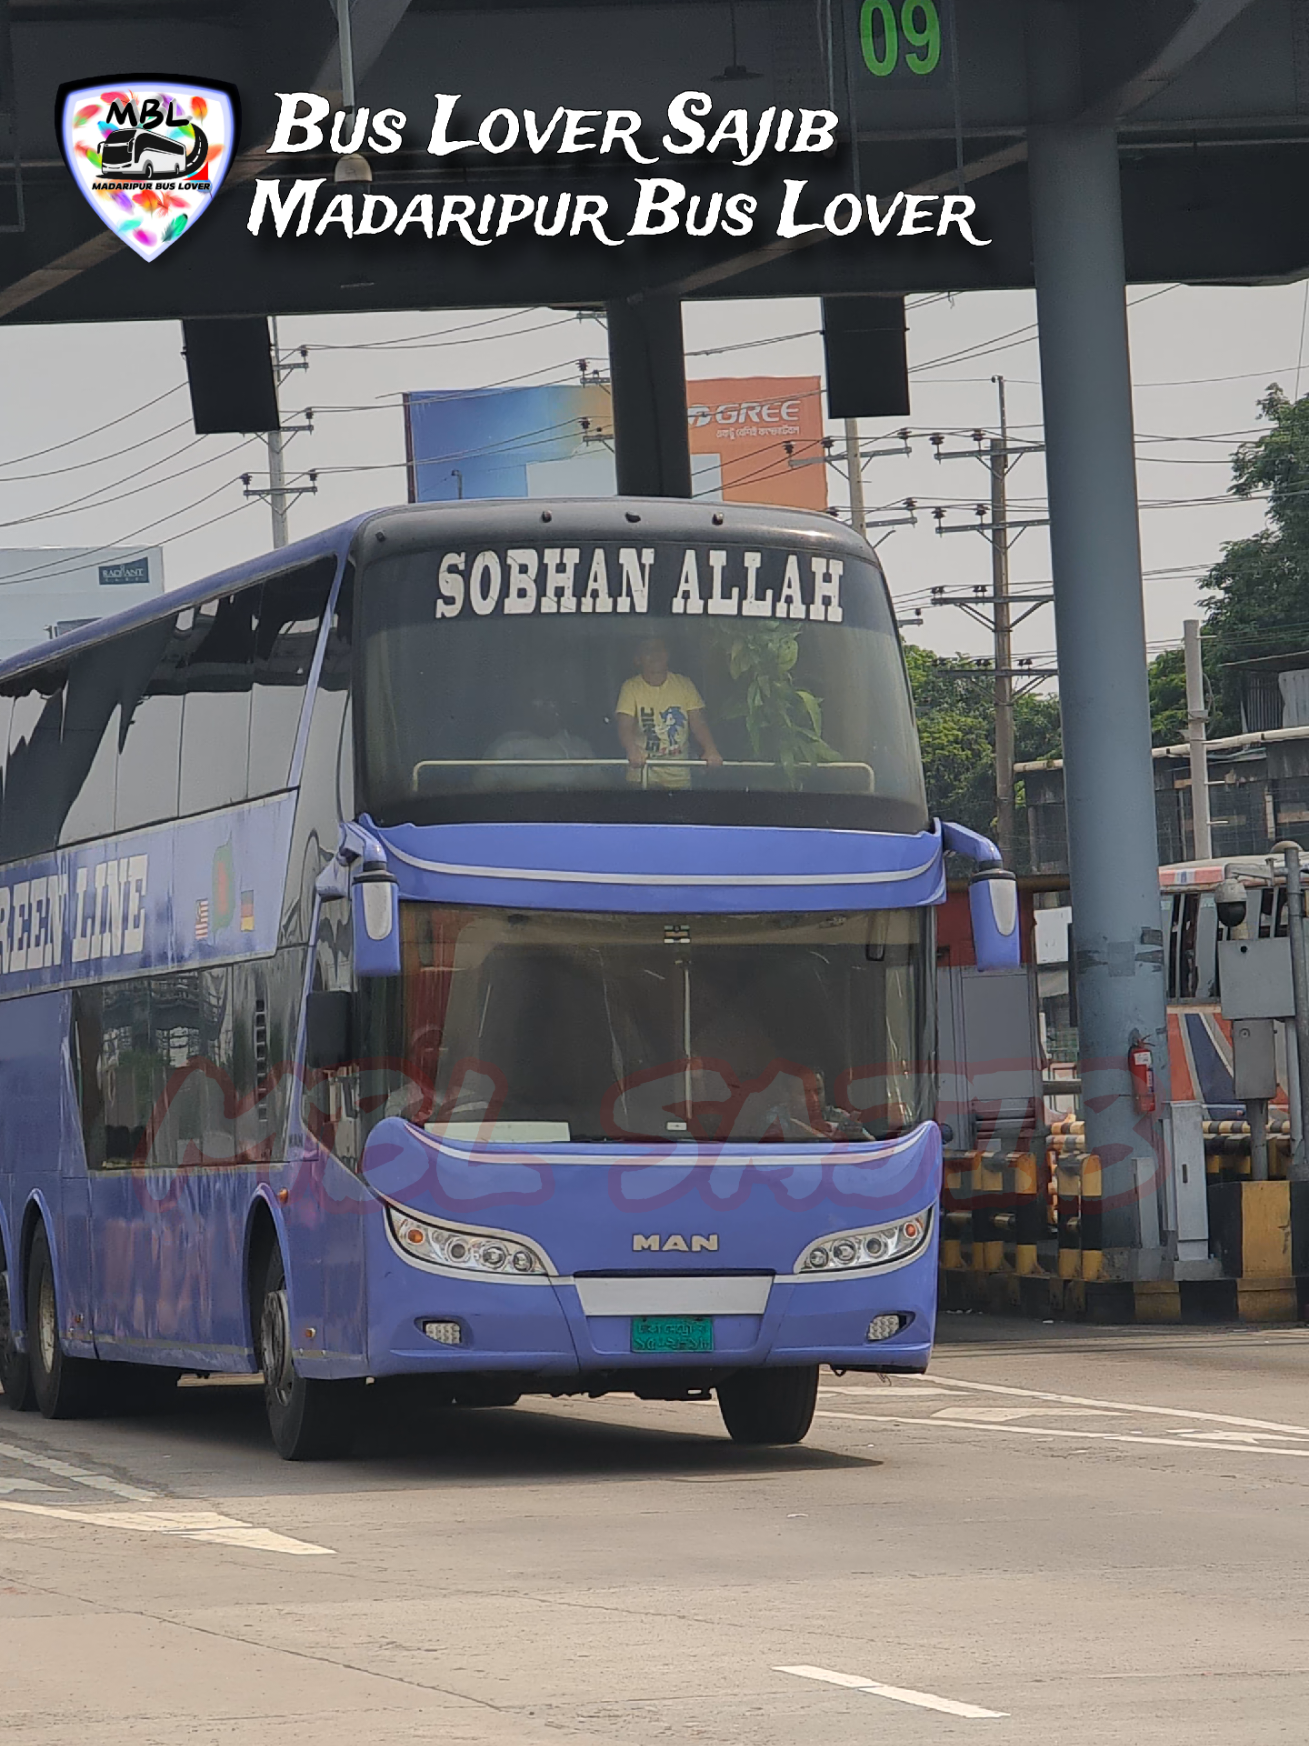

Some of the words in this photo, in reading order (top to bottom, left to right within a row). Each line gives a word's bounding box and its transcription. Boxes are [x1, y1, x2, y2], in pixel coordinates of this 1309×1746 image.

[861, 0, 941, 77] 09
[716, 400, 801, 424] GREE
[435, 547, 655, 619] SOBHAN
[672, 549, 844, 622] ALLAH
[72, 854, 148, 963] LINE
[632, 1233, 720, 1252] MAN
